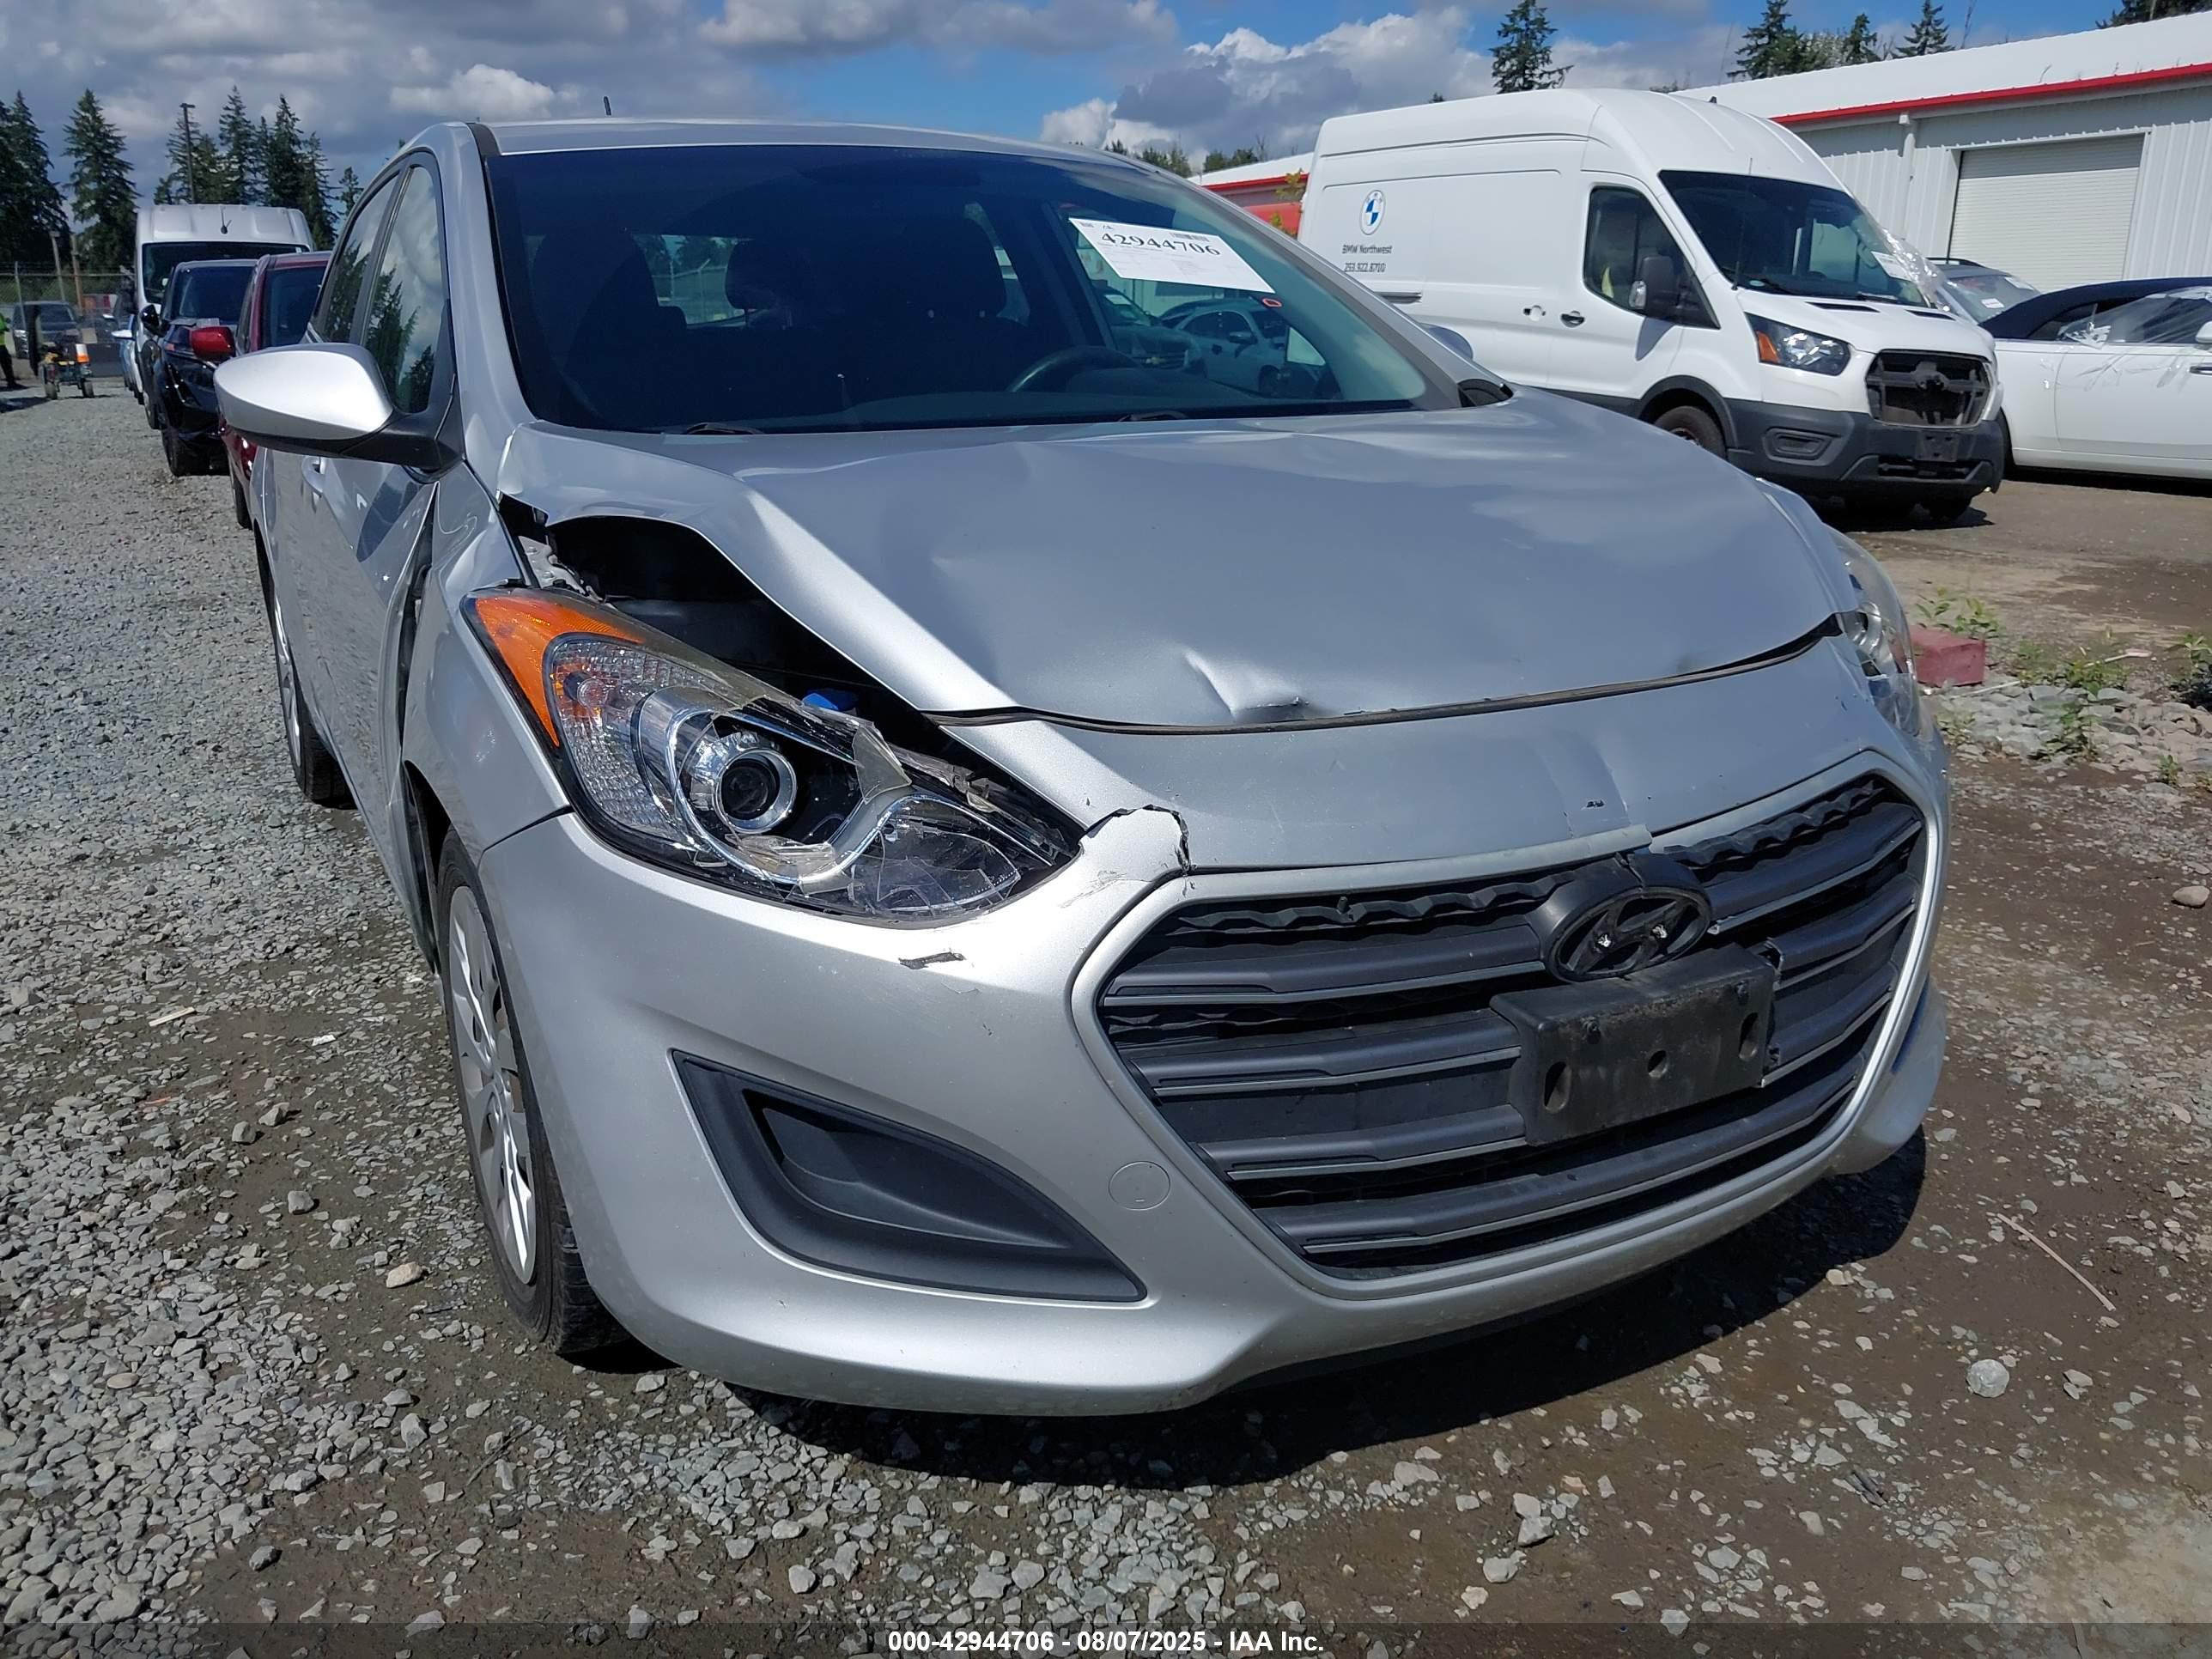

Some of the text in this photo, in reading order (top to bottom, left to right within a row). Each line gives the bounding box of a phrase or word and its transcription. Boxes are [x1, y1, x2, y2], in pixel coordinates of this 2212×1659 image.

[1102, 233, 1220, 256] 42944706
[1342, 245, 1393, 254] BMW Northwest
